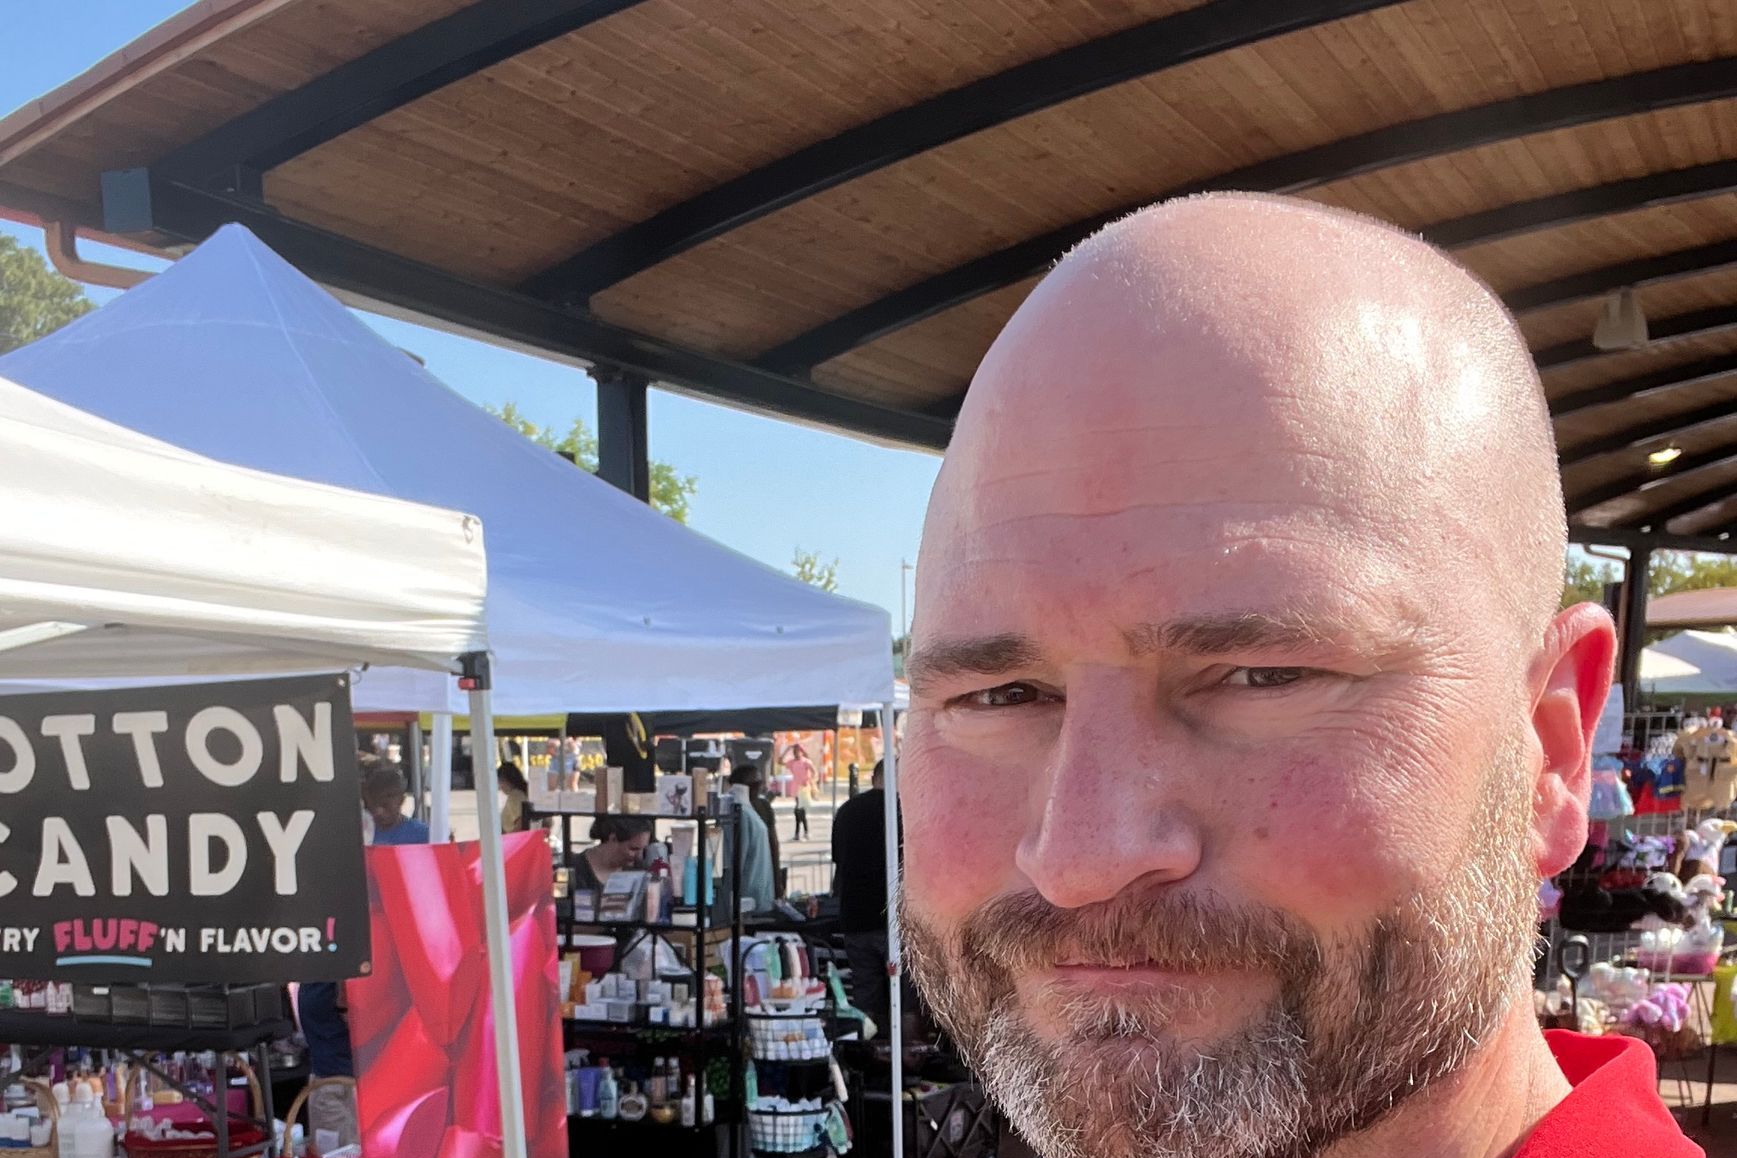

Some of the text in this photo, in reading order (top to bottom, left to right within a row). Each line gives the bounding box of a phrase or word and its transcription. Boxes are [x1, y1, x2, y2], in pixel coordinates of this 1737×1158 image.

[0, 810, 315, 898] ANDY
[0, 927, 40, 953] RY
[200, 917, 338, 953] FLAVOR!
